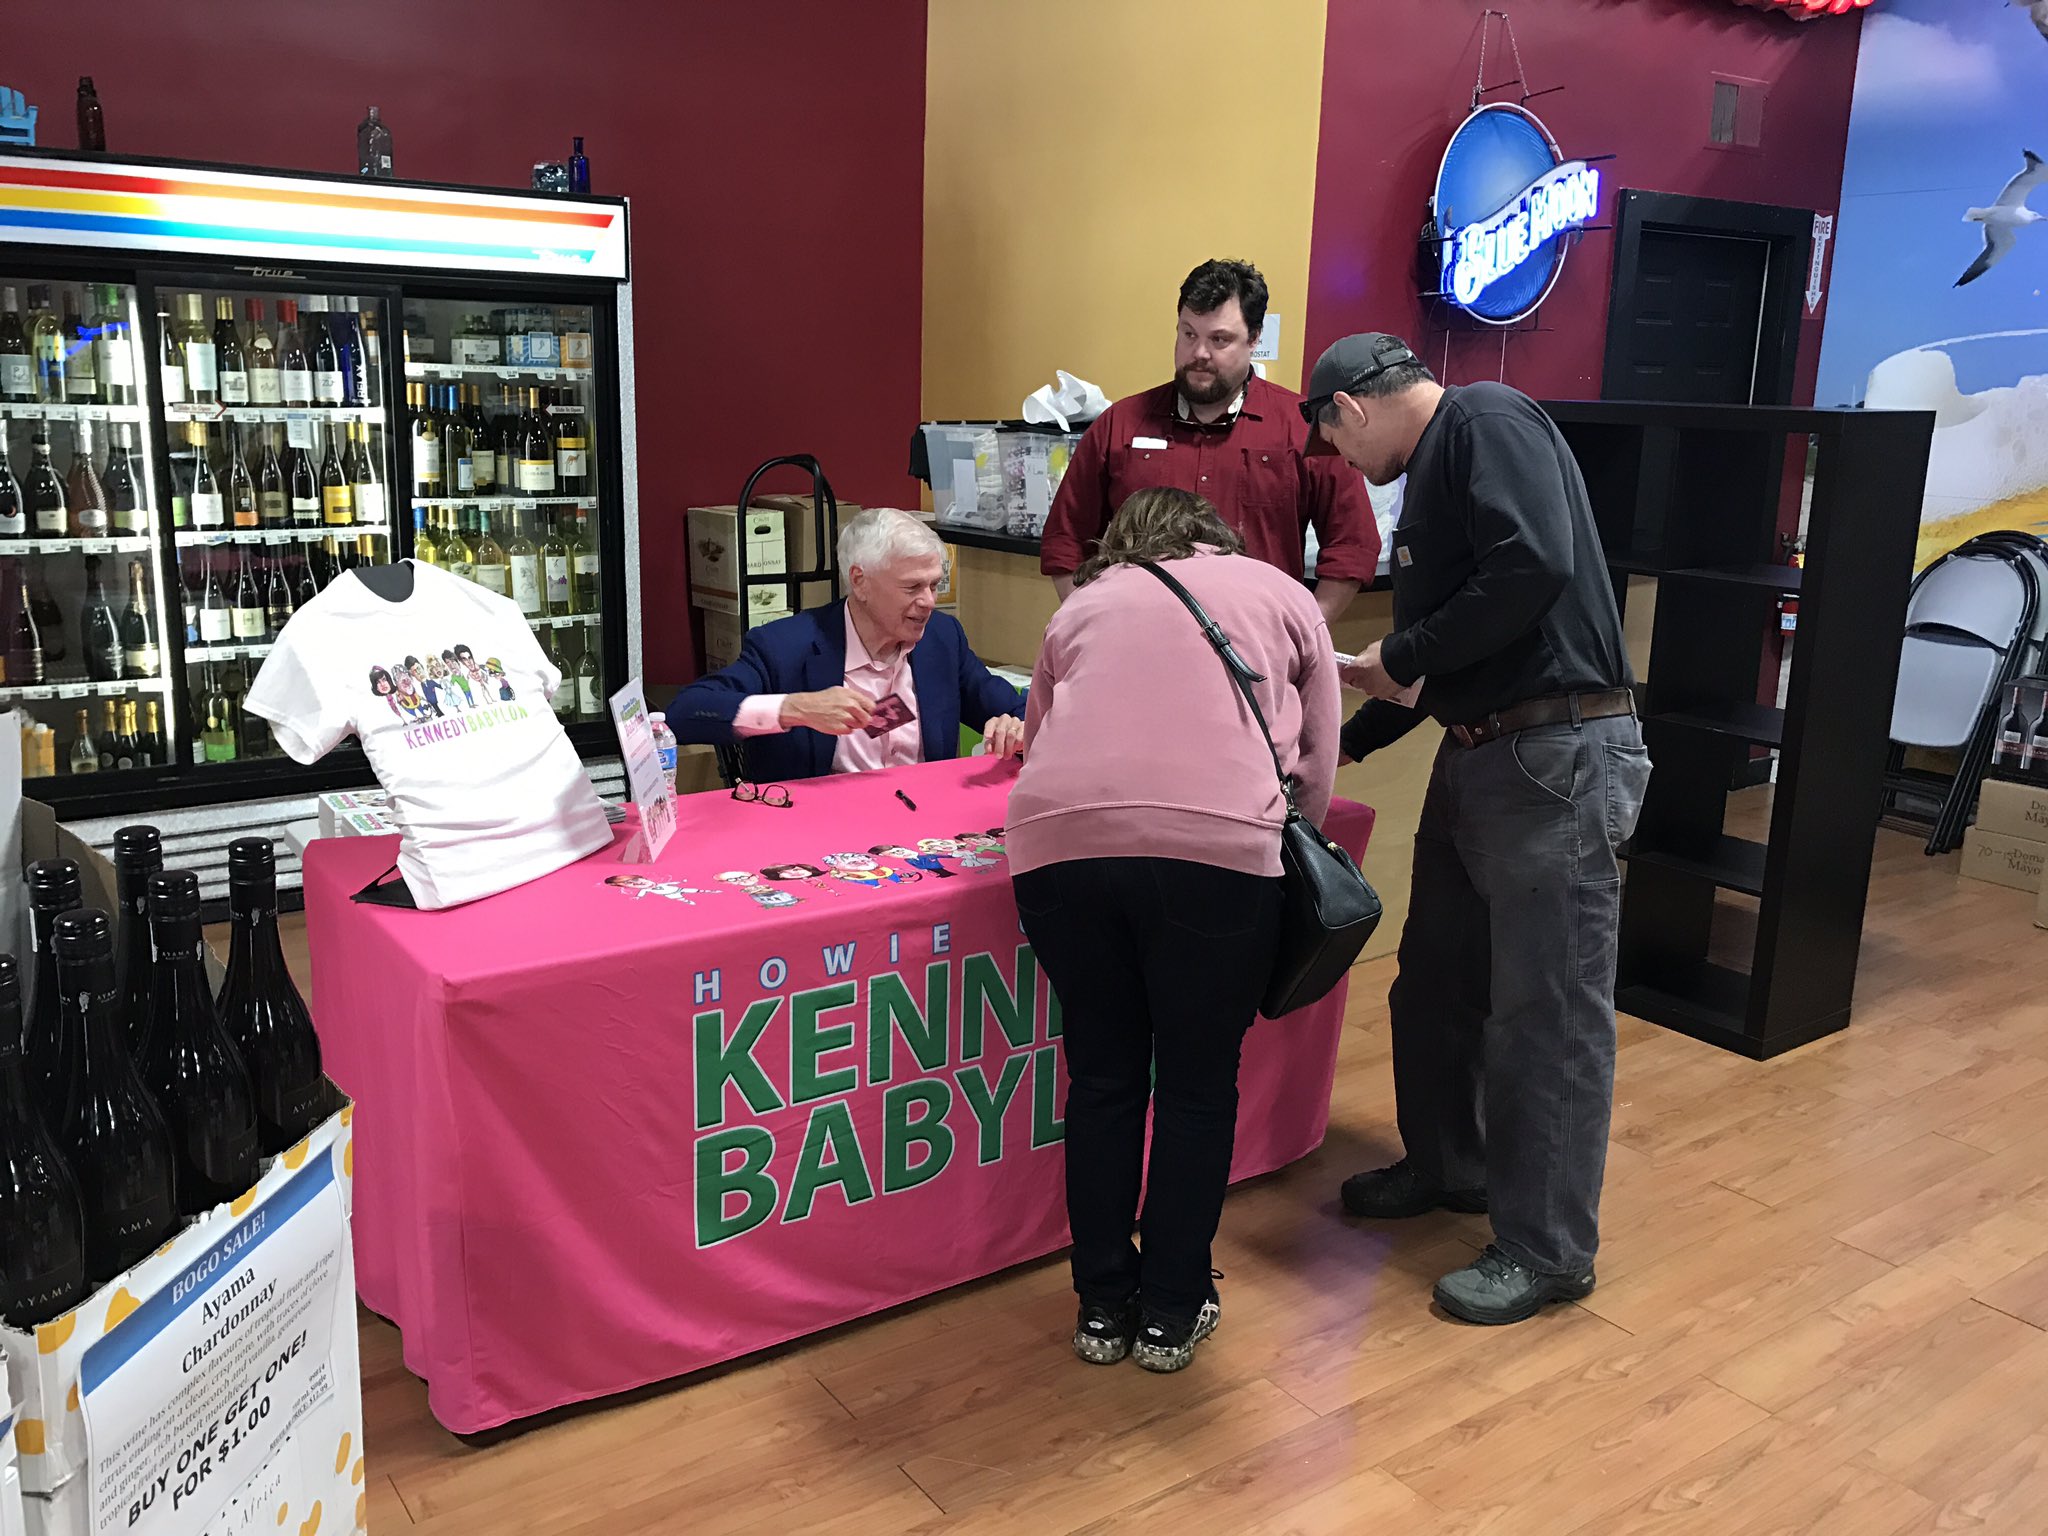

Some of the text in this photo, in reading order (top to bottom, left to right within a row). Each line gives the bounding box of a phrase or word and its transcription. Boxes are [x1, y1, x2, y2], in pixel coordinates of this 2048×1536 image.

[1810, 236, 1822, 309] EXTINGUISHER
[1814, 220, 1831, 235] FIRE
[693, 922, 952, 1004] HOWIE
[692, 942, 1064, 1132] KENN
[694, 1044, 1067, 1250] BABYL
[15, 1280, 73, 1309] AYAMA
[173, 1210, 267, 1306] BOGO SALE!
[202, 1267, 256, 1326] Ayama
[98, 1460, 128, 1494] citrus
[129, 1427, 162, 1465] ending
[163, 1412, 176, 1430] on
[211, 1360, 233, 1386] crisp
[256, 1319, 275, 1342] with
[276, 1298, 300, 1324] traces
[300, 1284, 310, 1301] of
[309, 1269, 329, 1292] clove
[100, 1448, 121, 1475] This
[122, 1424, 148, 1452] wine
[149, 1406, 166, 1429] has
[167, 1371, 206, 1411] complex
[208, 1337, 243, 1374] flavours
[244, 1320, 257, 1339] of
[254, 1292, 286, 1330] tropical
[286, 1275, 304, 1300] fruit
[303, 1261, 319, 1283] and
[181, 1277, 278, 1374] Chardonnay
[99, 1484, 118, 1513] and
[152, 1432, 171, 1457] rich
[173, 1377, 230, 1437] butterscotch
[231, 1359, 248, 1383] and
[99, 1483, 136, 1531] tropical
[137, 1462, 158, 1492] fruit
[158, 1443, 177, 1468] and
[185, 1416, 204, 1440] soft
[128, 1328, 307, 1529] BUY ONE GET ONE!
[172, 1395, 271, 1512] FOR $1.00
